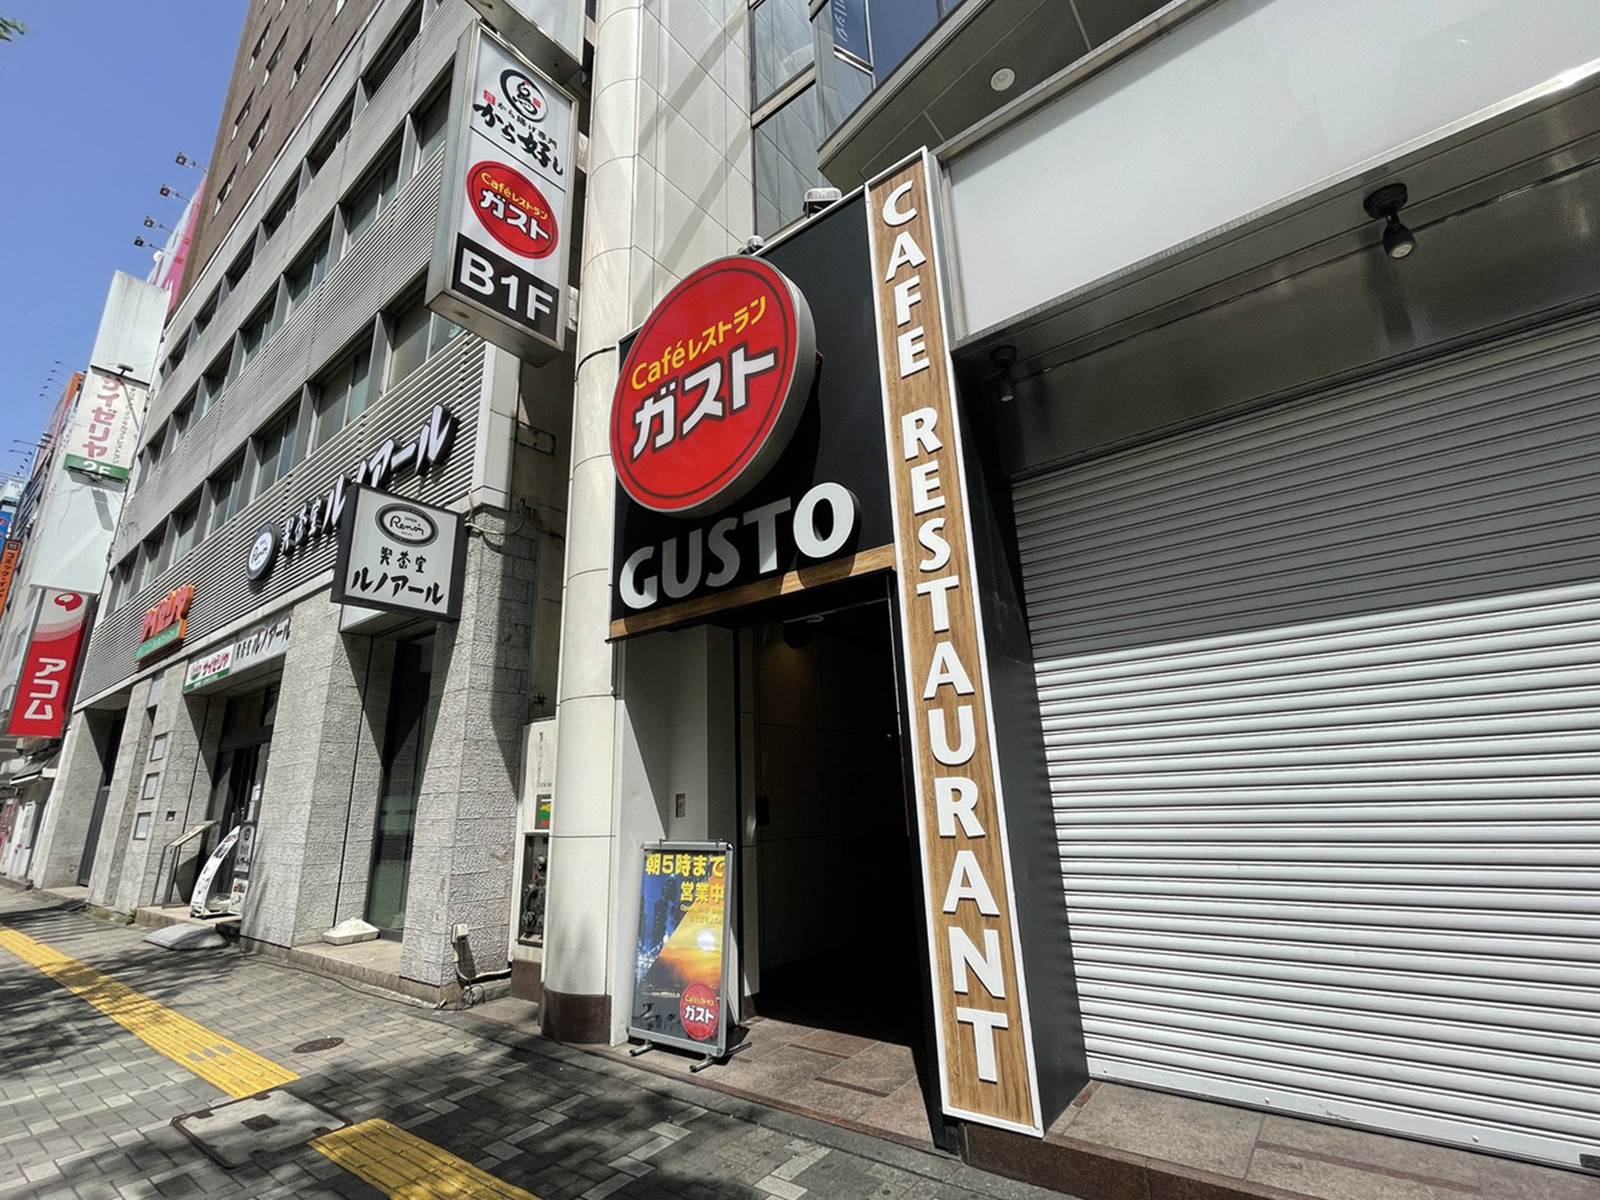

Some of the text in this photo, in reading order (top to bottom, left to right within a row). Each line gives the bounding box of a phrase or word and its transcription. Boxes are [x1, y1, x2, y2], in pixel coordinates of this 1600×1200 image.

[480, 189, 551, 241] ガスト
[459, 247, 553, 321] B1F
[632, 296, 766, 390] Caféレストラン
[631, 347, 776, 463] ガスト
[380, 546, 427, 574] 喫茶室
[619, 482, 855, 610] GUSTO
[351, 567, 444, 606] ルノアール
[881, 179, 1008, 1084] CAFE RESTAURANT
[24, 657, 67, 721] アコム
[645, 852, 726, 878] 朝5時まで
[680, 881, 724, 904] 営業中
[684, 1004, 715, 1024] ガスト
